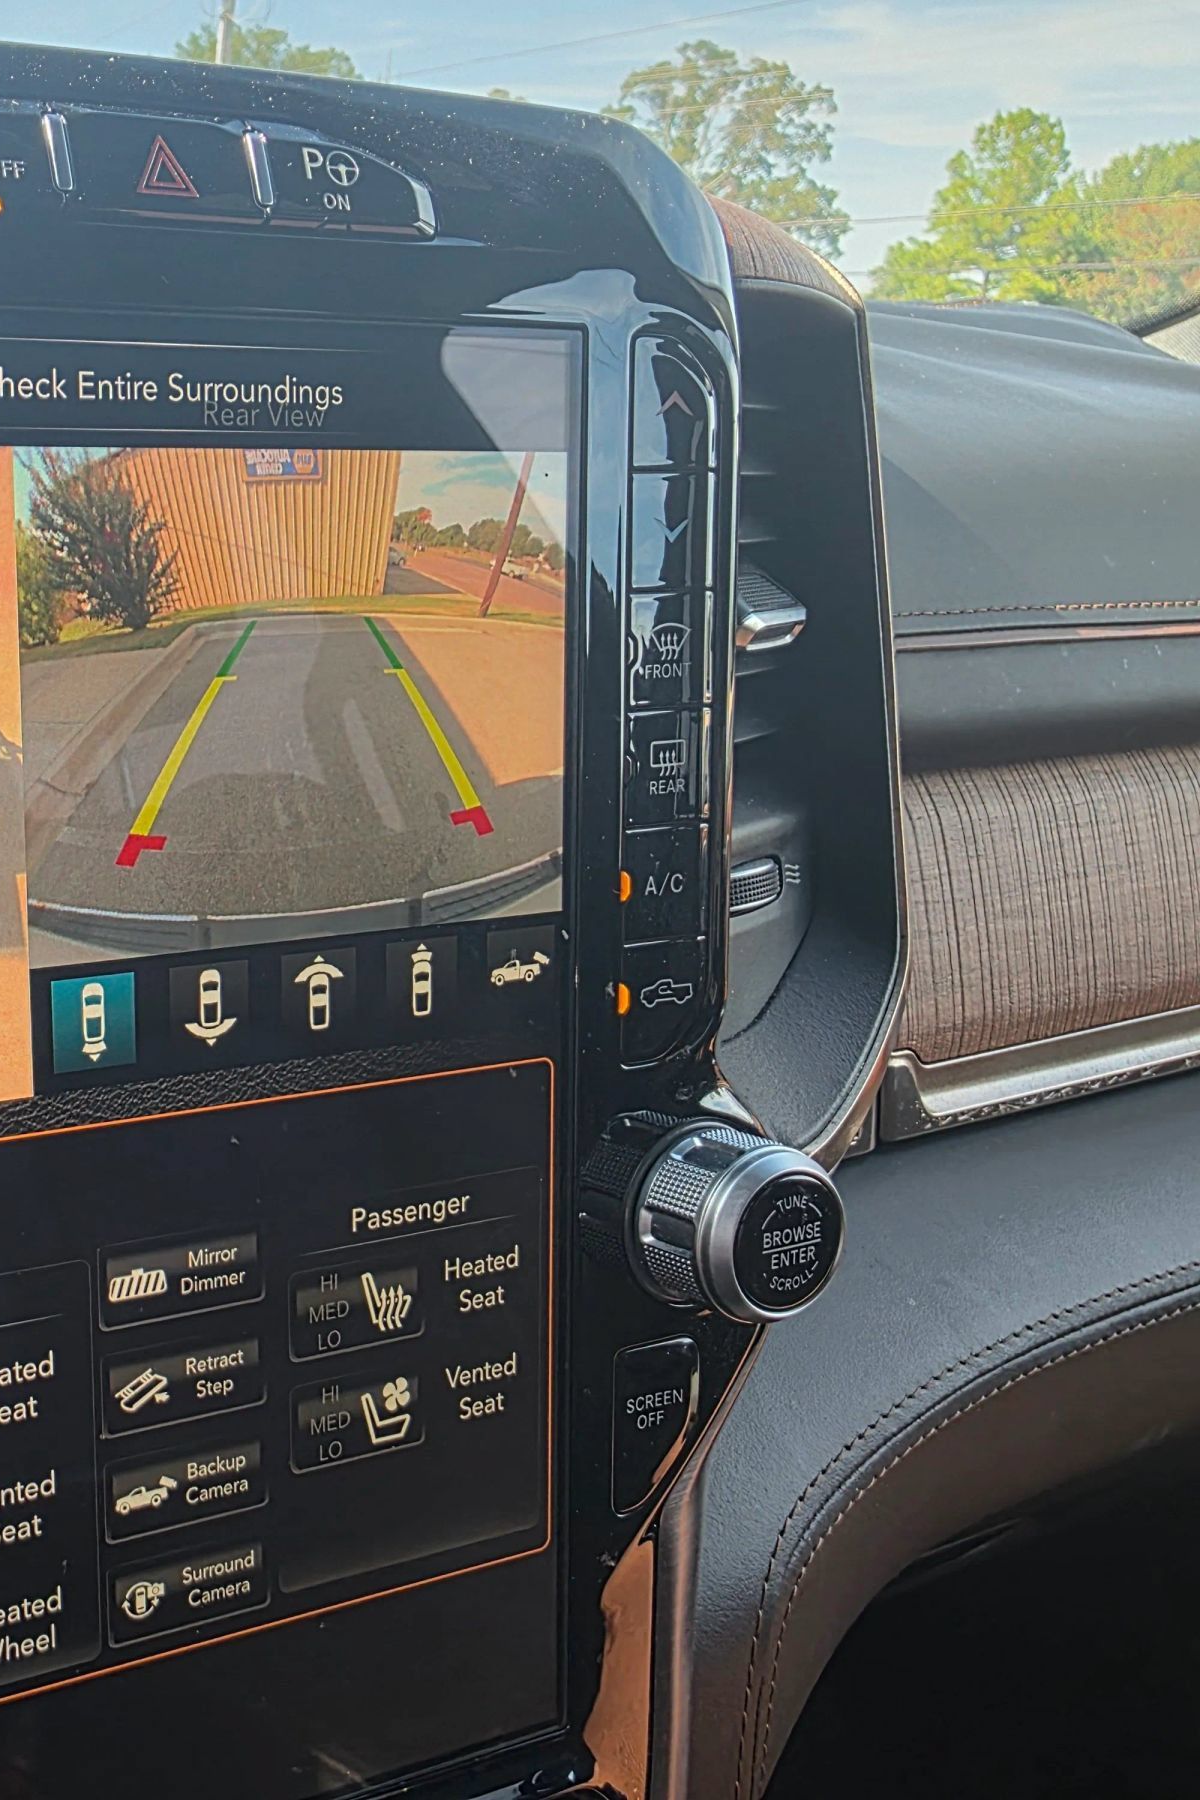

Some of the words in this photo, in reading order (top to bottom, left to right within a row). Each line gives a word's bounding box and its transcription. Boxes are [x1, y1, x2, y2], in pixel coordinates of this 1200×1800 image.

[323, 193, 351, 211] ON
[78, 370, 158, 401] Entire
[168, 372, 343, 411] Surroundings
[203, 400, 260, 427] Rear
[267, 401, 326, 428] View
[644, 661, 692, 681] FRONT
[648, 779, 687, 796] REAR
[644, 872, 684, 897] A/C
[351, 1192, 471, 1233] Passenger
[776, 1194, 809, 1214] TUNE
[763, 1221, 822, 1249] BROWSE
[188, 1247, 238, 1269] Mirror
[444, 1245, 520, 1282] Heated
[771, 1245, 816, 1270] ENTER
[180, 1271, 246, 1296] Dimmer
[320, 1274, 338, 1292] HI
[769, 1270, 813, 1292] SCROLL
[458, 1284, 506, 1314] Seat
[308, 1300, 349, 1325] MED
[317, 1330, 341, 1351] LO
[185, 1349, 245, 1376] Retract
[445, 1352, 518, 1391] Vented
[196, 1378, 234, 1399] Step
[321, 1384, 340, 1403] HI
[625, 1388, 684, 1414] SCREEN
[458, 1390, 506, 1421] Seat
[310, 1411, 351, 1436] MED
[636, 1410, 665, 1430] OFF
[319, 1441, 343, 1462] LO
[187, 1454, 247, 1481] Backup
[185, 1479, 250, 1505] Camera
[182, 1549, 256, 1585] Surround
[188, 1580, 251, 1607] Camera
